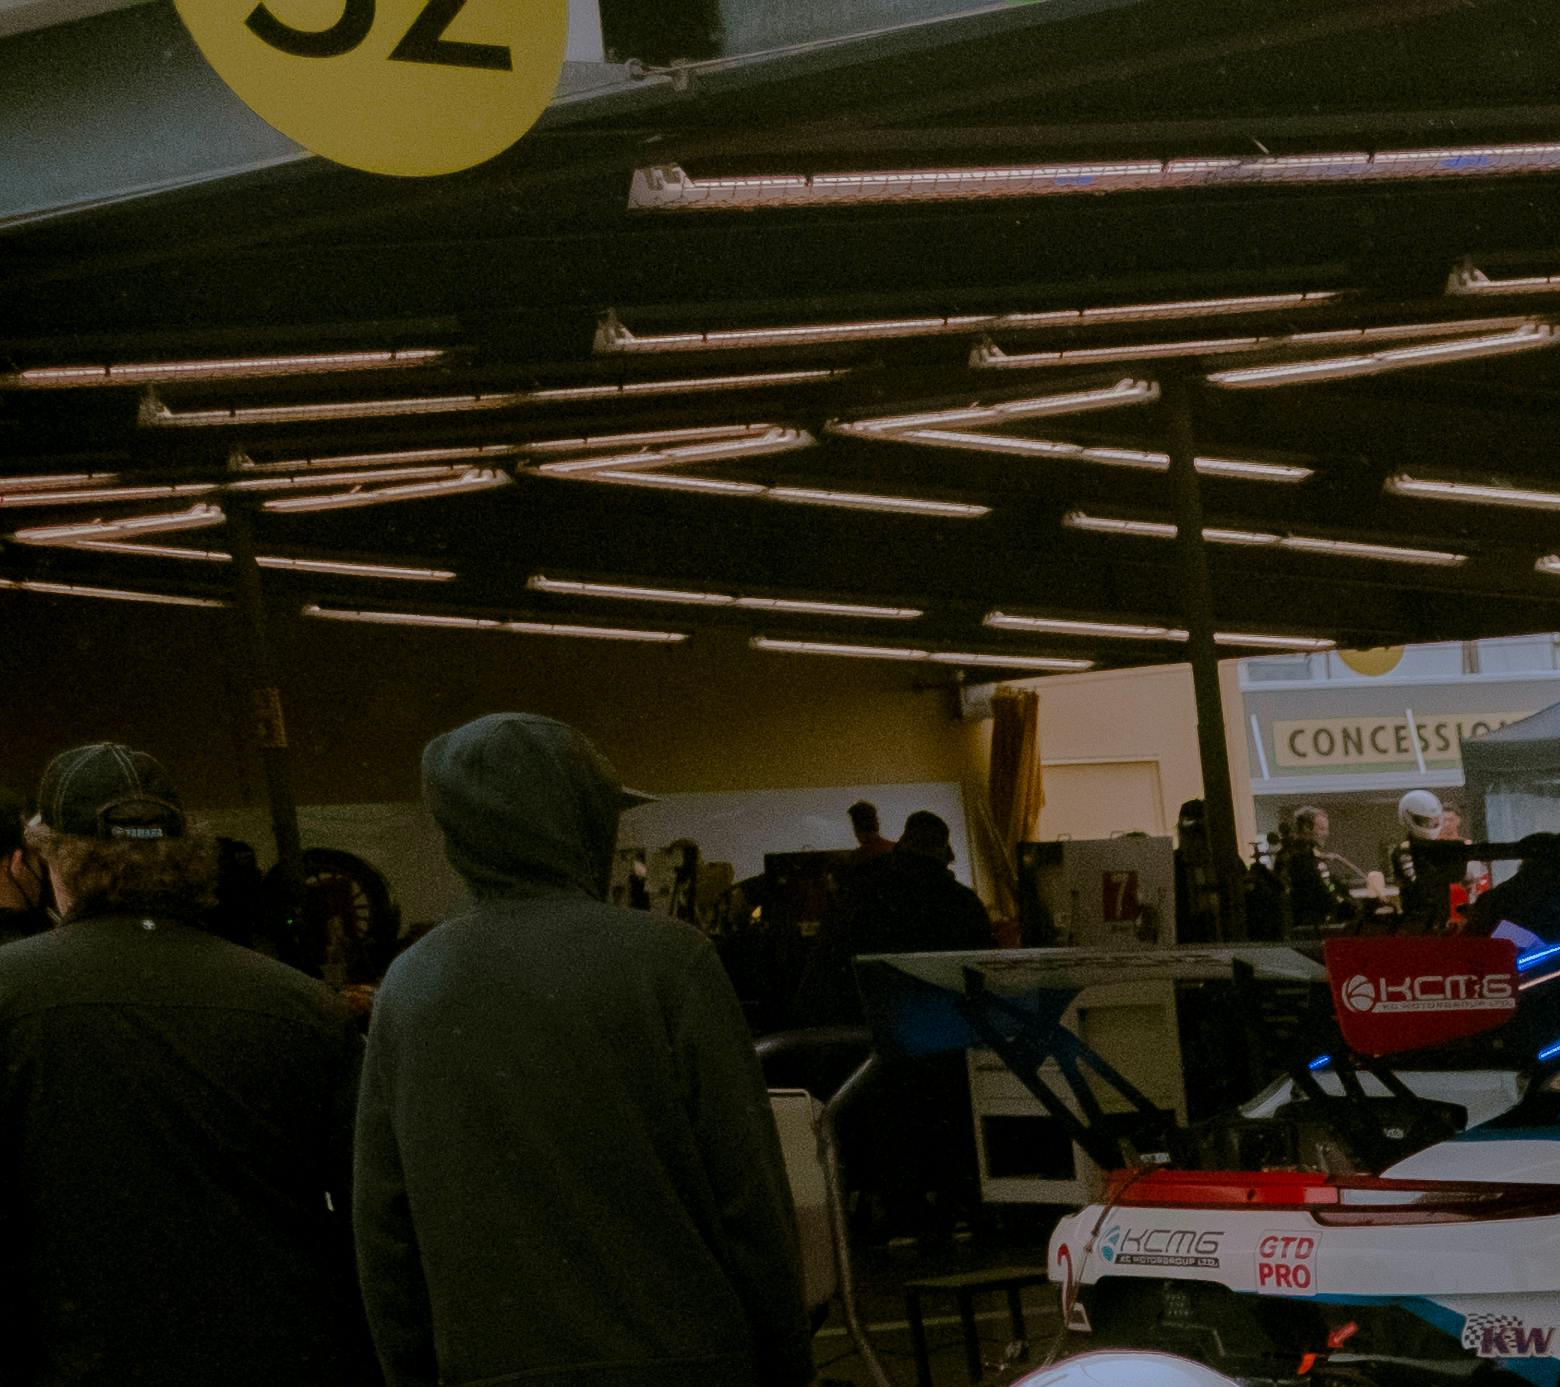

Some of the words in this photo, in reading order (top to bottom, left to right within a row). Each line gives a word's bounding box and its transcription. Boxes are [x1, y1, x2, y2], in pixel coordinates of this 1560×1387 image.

[1289, 718, 1503, 757] CONCESSIO
[1120, 1228, 1226, 1255] KCMG
[1258, 1235, 1315, 1260] GTD
[1258, 1263, 1311, 1290] PRO
[1481, 1327, 1556, 1354] KW
